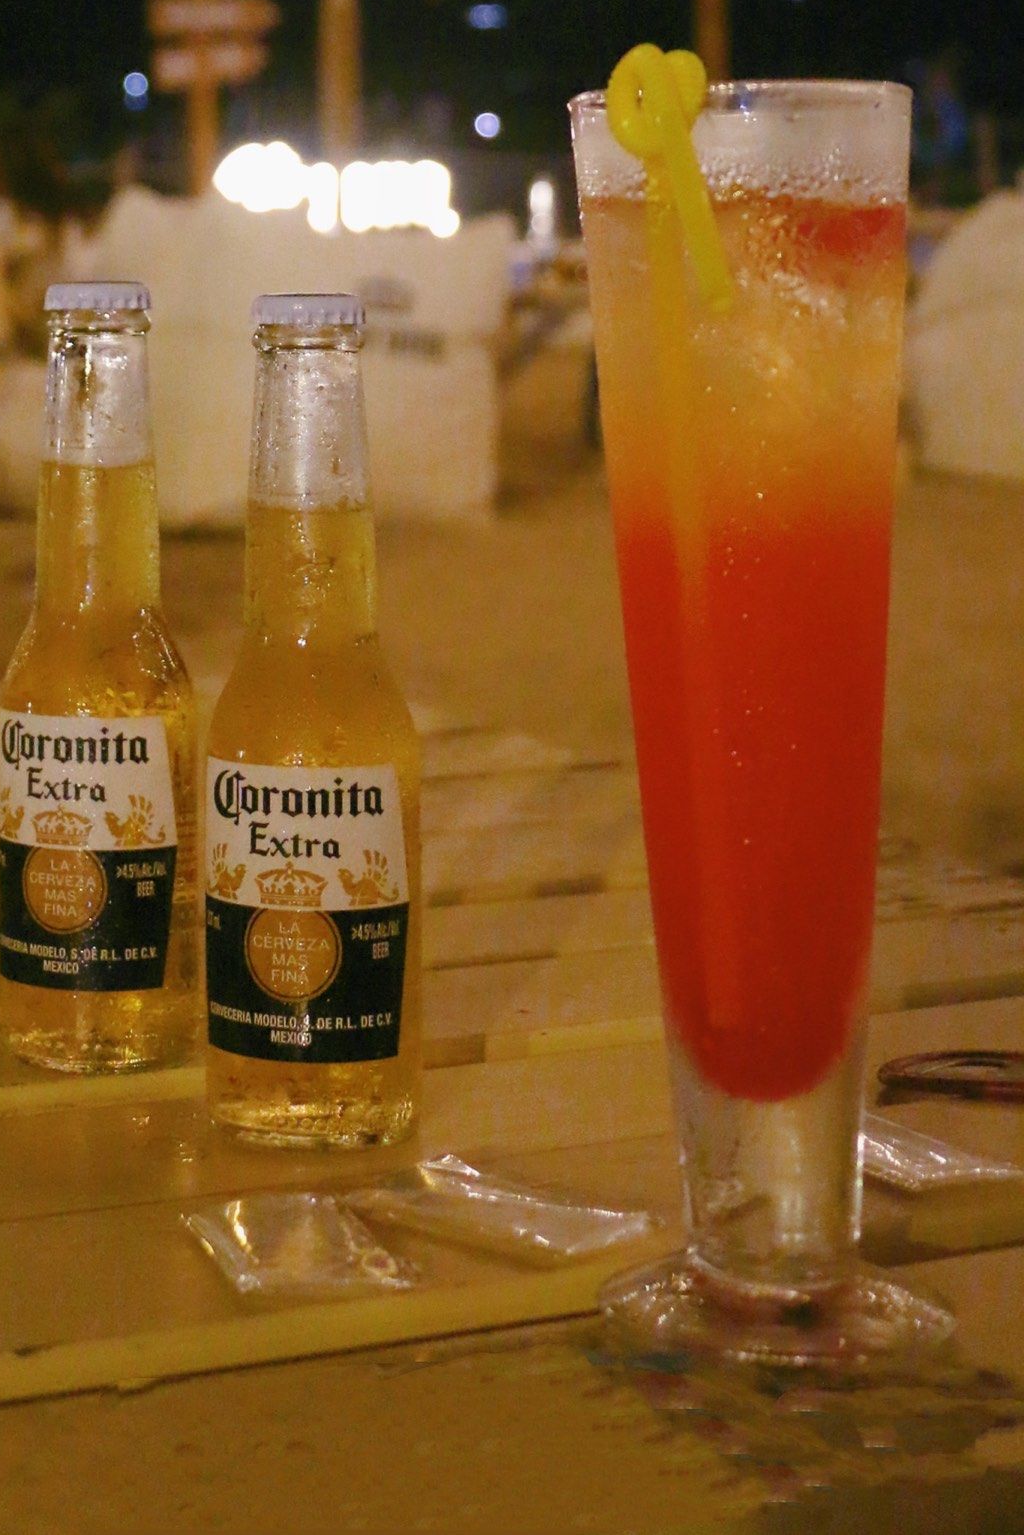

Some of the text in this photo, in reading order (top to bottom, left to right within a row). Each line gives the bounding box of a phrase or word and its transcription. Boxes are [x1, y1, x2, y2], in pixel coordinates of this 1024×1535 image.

[1, 719, 149, 769] Coronita
[27, 767, 107, 803] Extra
[214, 769, 384, 824] Coronita
[250, 822, 342, 860] Extra
[50, 859, 70, 871] LA
[29, 872, 97, 888] CERVEZA
[44, 903, 76, 916] FINA
[278, 922, 301, 934] LA
[253, 935, 330, 951] CERVEZA
[83, 948, 98, 961] DE
[125, 948, 138, 961] DE
[43, 960, 80, 975] MEXICO
[271, 969, 309, 983] FINA
[317, 1018, 333, 1030] DE
[361, 1015, 374, 1029] DE
[271, 1030, 312, 1046] MEXICO
